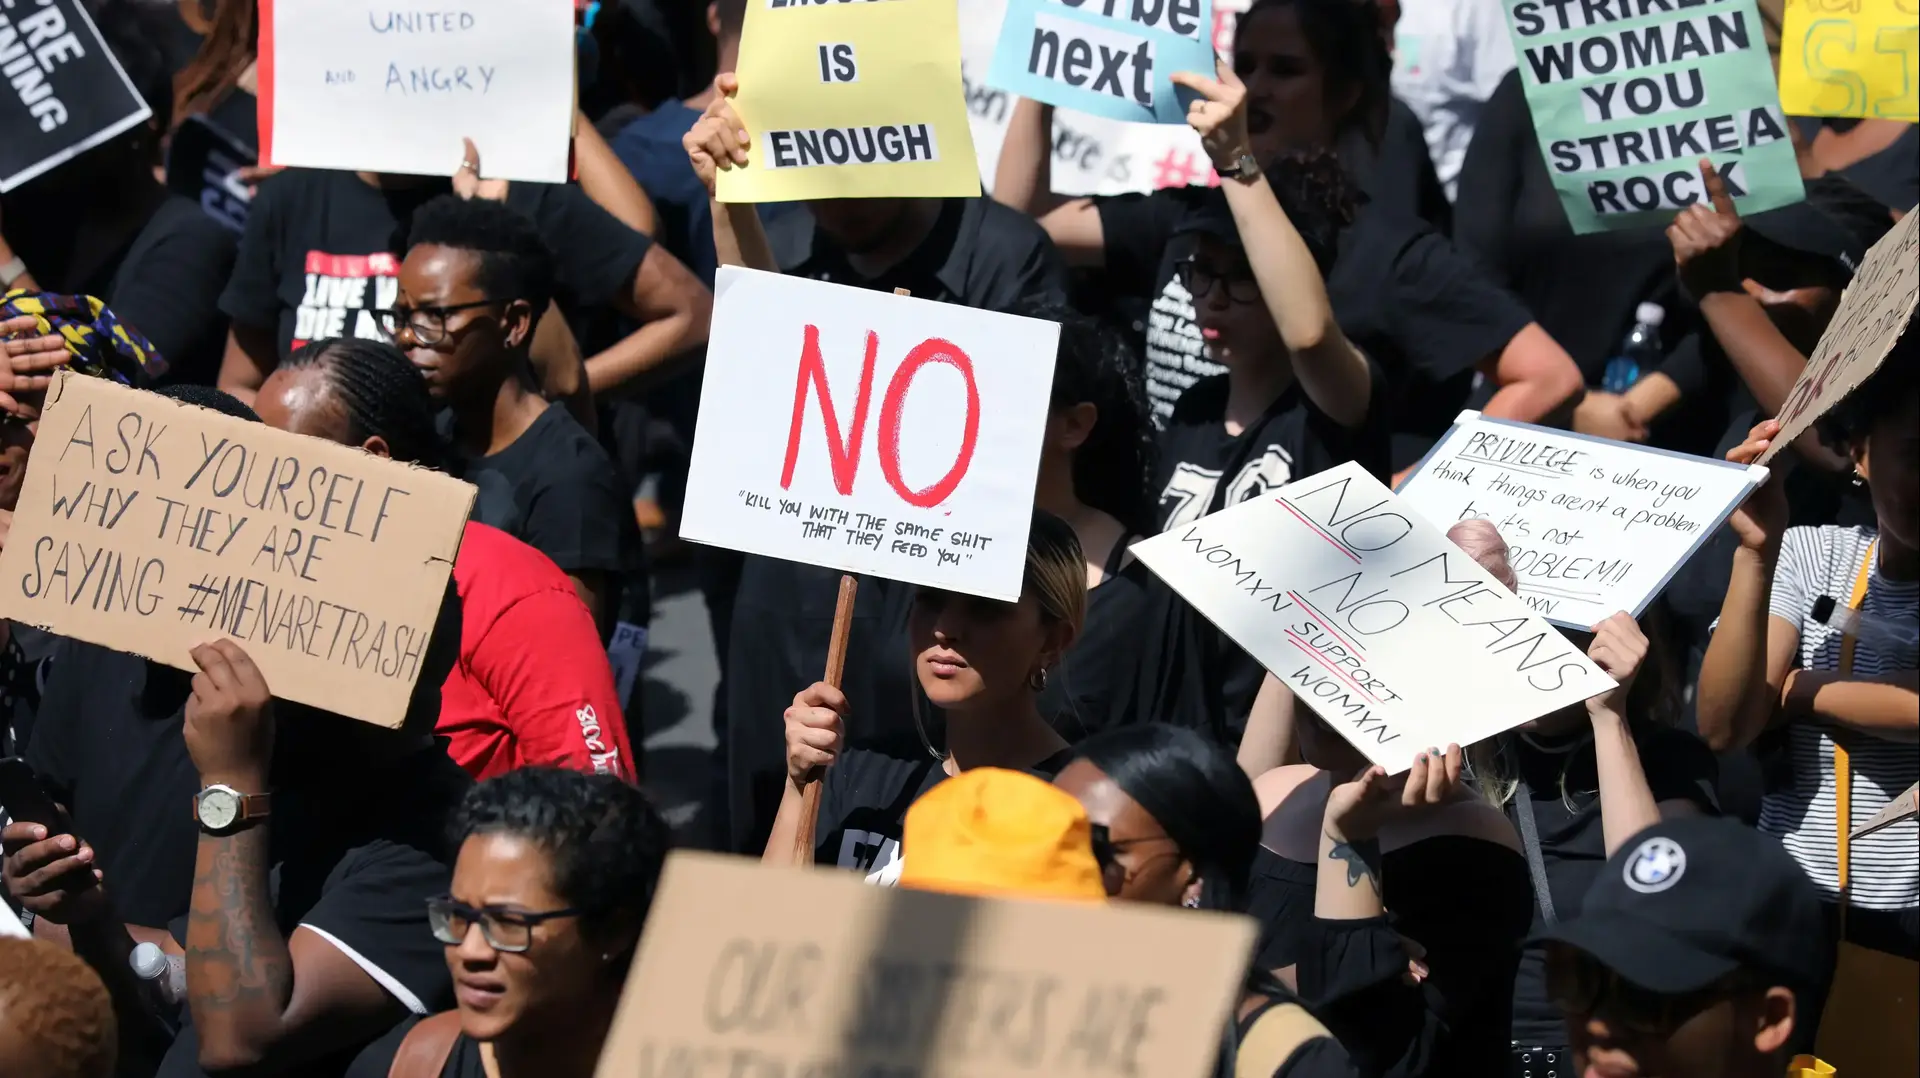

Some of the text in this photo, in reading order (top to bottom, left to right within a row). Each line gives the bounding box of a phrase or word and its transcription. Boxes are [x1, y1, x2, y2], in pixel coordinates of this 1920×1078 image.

[3, 0, 86, 73] 'RE
[368, 11, 475, 34] UNITED
[1512, 0, 1698, 36] STRI
[1524, 11, 1751, 84] WOMAN
[0, 13, 69, 133] NING
[325, 61, 496, 97] AND ANGRY
[819, 44, 856, 82] IS
[1027, 27, 1153, 104] next
[1581, 68, 1705, 122] YOU
[769, 123, 933, 167] ENOUGH
[1550, 106, 1785, 173] STRIKE A
[1587, 161, 1747, 214] ROCK
[294, 304, 347, 341] DIE
[302, 273, 368, 309] LIVE
[780, 323, 981, 509] NO
[58, 403, 411, 543] ASK YOURSELF
[1432, 459, 1702, 535] think things aren't a problem
[1459, 431, 1702, 508] PRIVILEGE is when you
[52, 474, 331, 582] WHY THEY ARE
[801, 521, 837, 541] THAT
[845, 529, 884, 551] THEY
[891, 540, 928, 558] FEED
[855, 513, 888, 531] THE
[950, 531, 993, 551] SHIT
[1496, 512, 1531, 537] it's
[1542, 528, 1585, 546] not
[22, 535, 427, 683] SAYING #MENARETRASH
[1181, 526, 1404, 702] WOMXN SUPPORT
[1294, 477, 1588, 692] NO MEANS
[1308, 571, 1410, 636] NO
[575, 703, 606, 752] 2018
[1290, 665, 1401, 744] WOMXN
